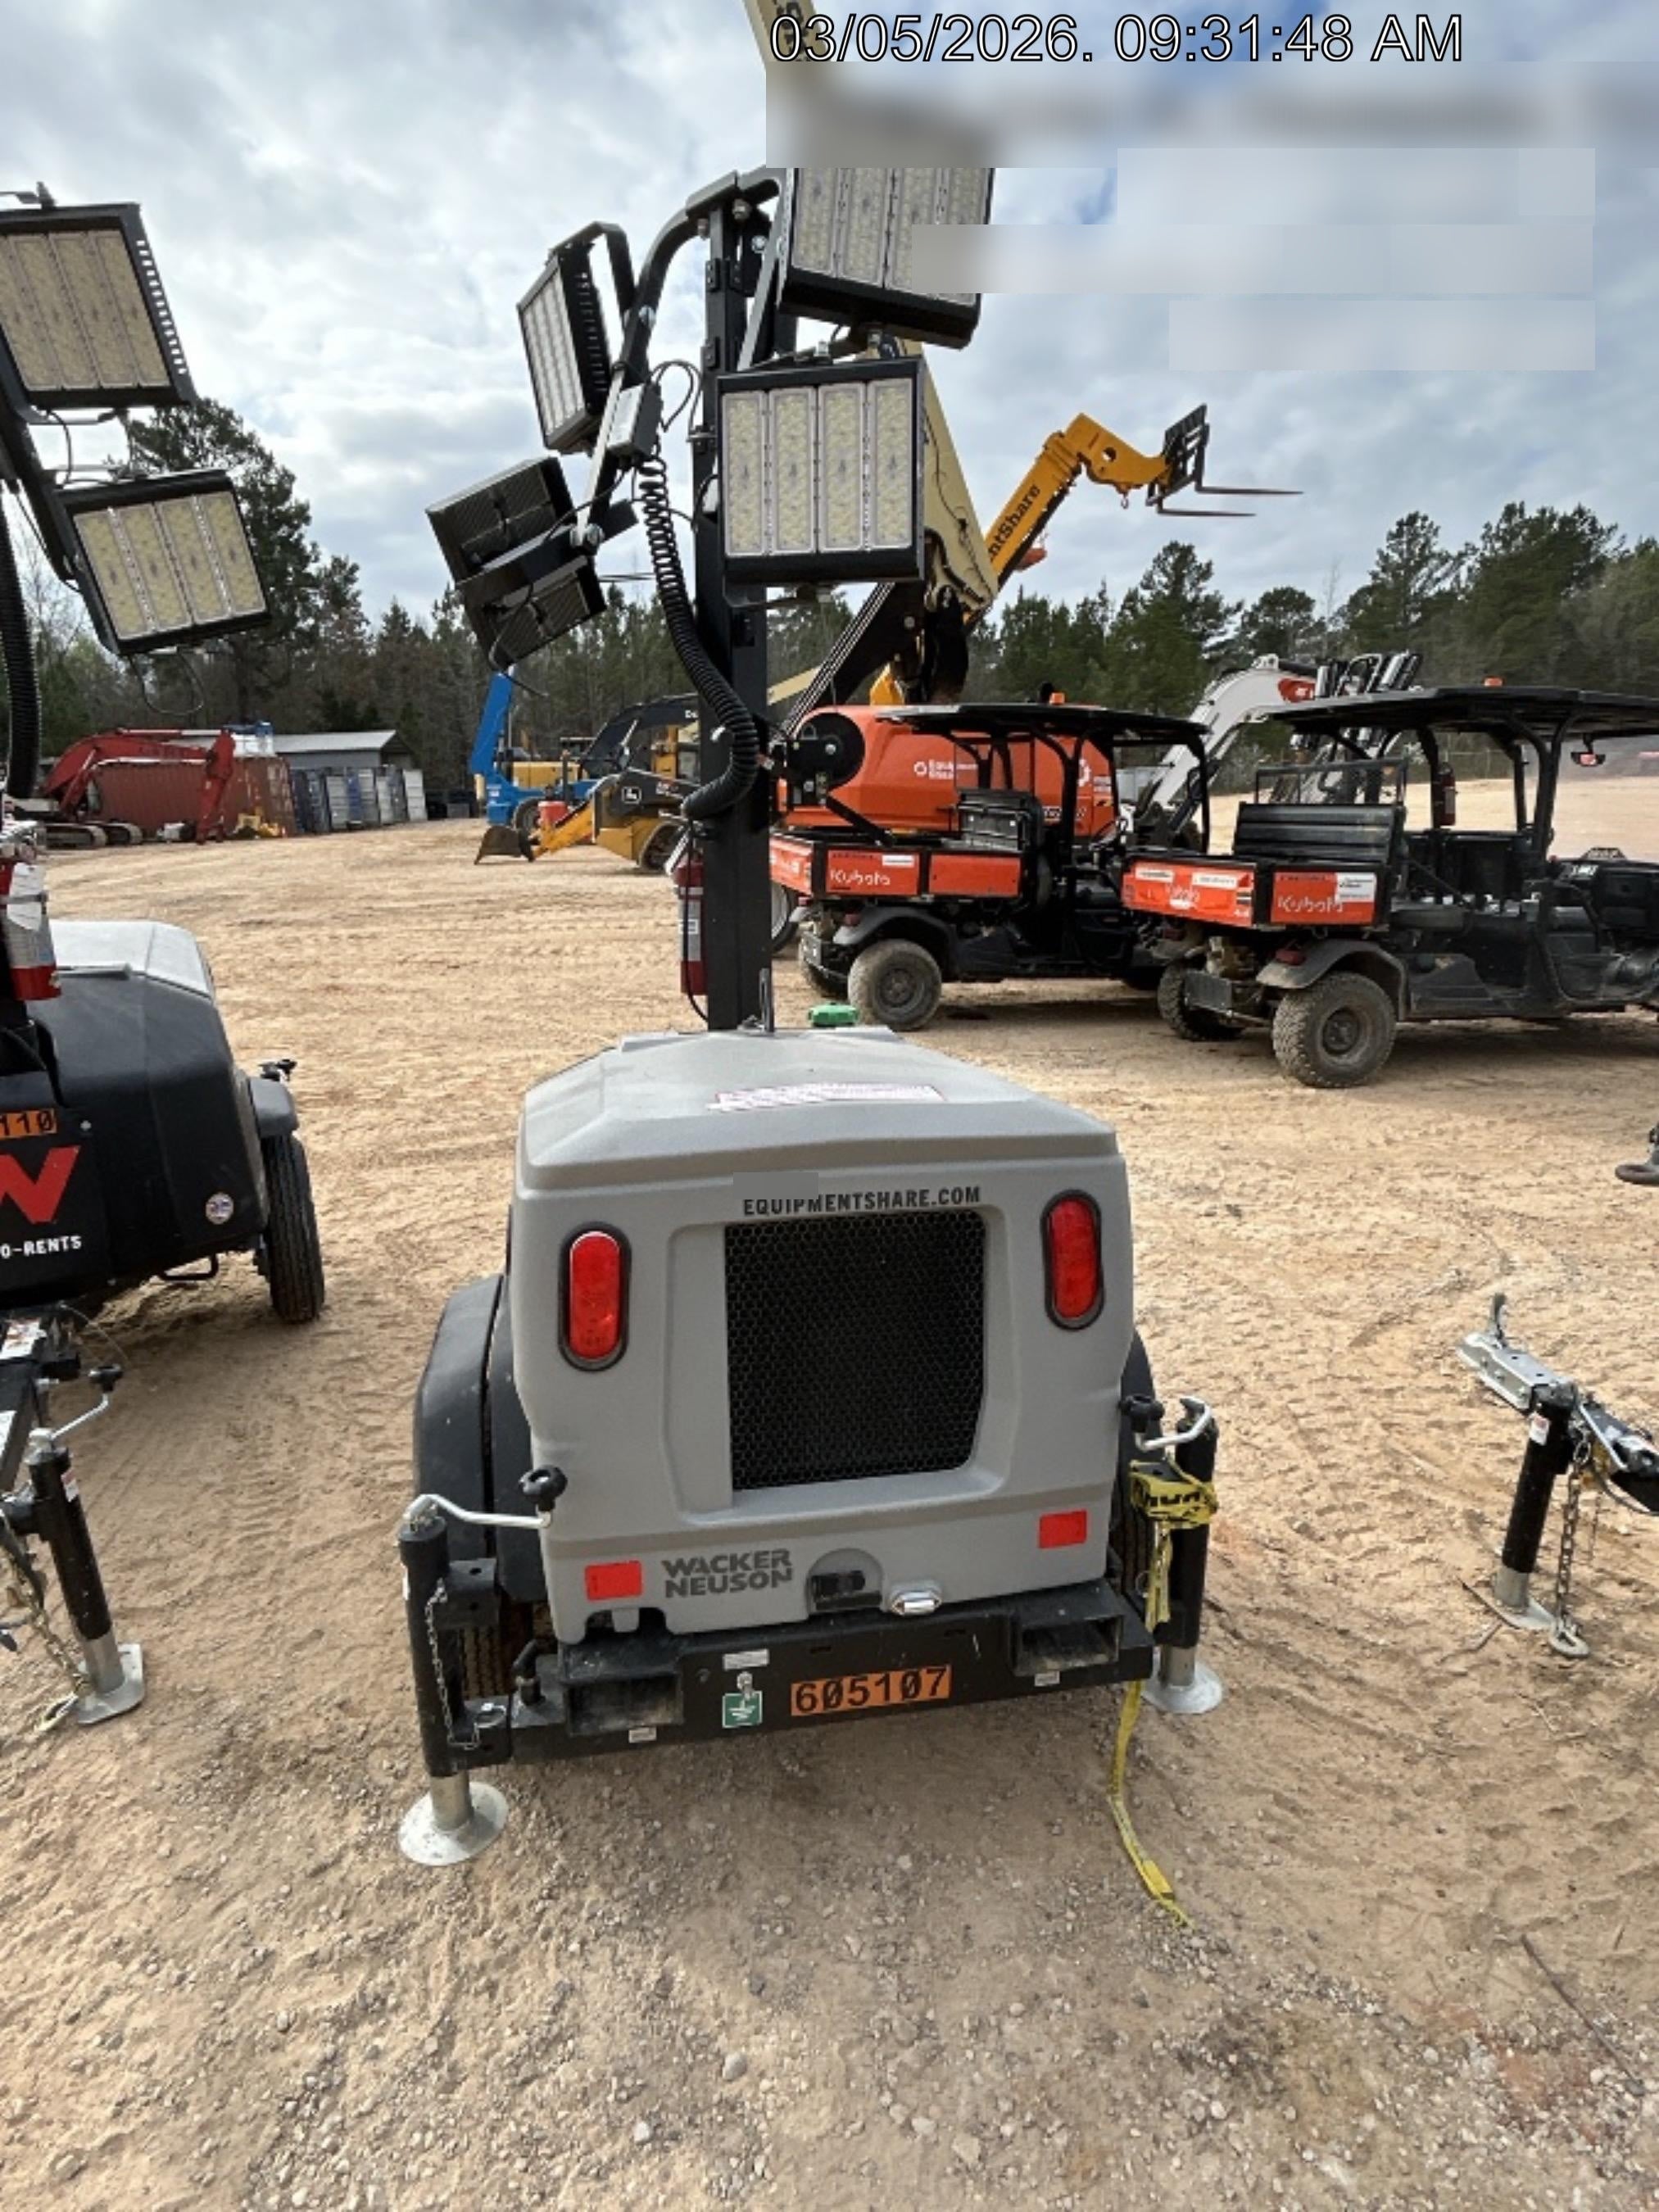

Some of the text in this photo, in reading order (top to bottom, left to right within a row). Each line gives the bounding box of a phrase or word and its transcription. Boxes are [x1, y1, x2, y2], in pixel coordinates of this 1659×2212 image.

[830, 868, 891, 886] Kubota
[744, 1186, 980, 1217] EQUIPMENTSHARE.COM
[661, 1548, 792, 1578] WACKER
[665, 1566, 793, 1598] NEUSON
[795, 1668, 947, 1712] 605107
